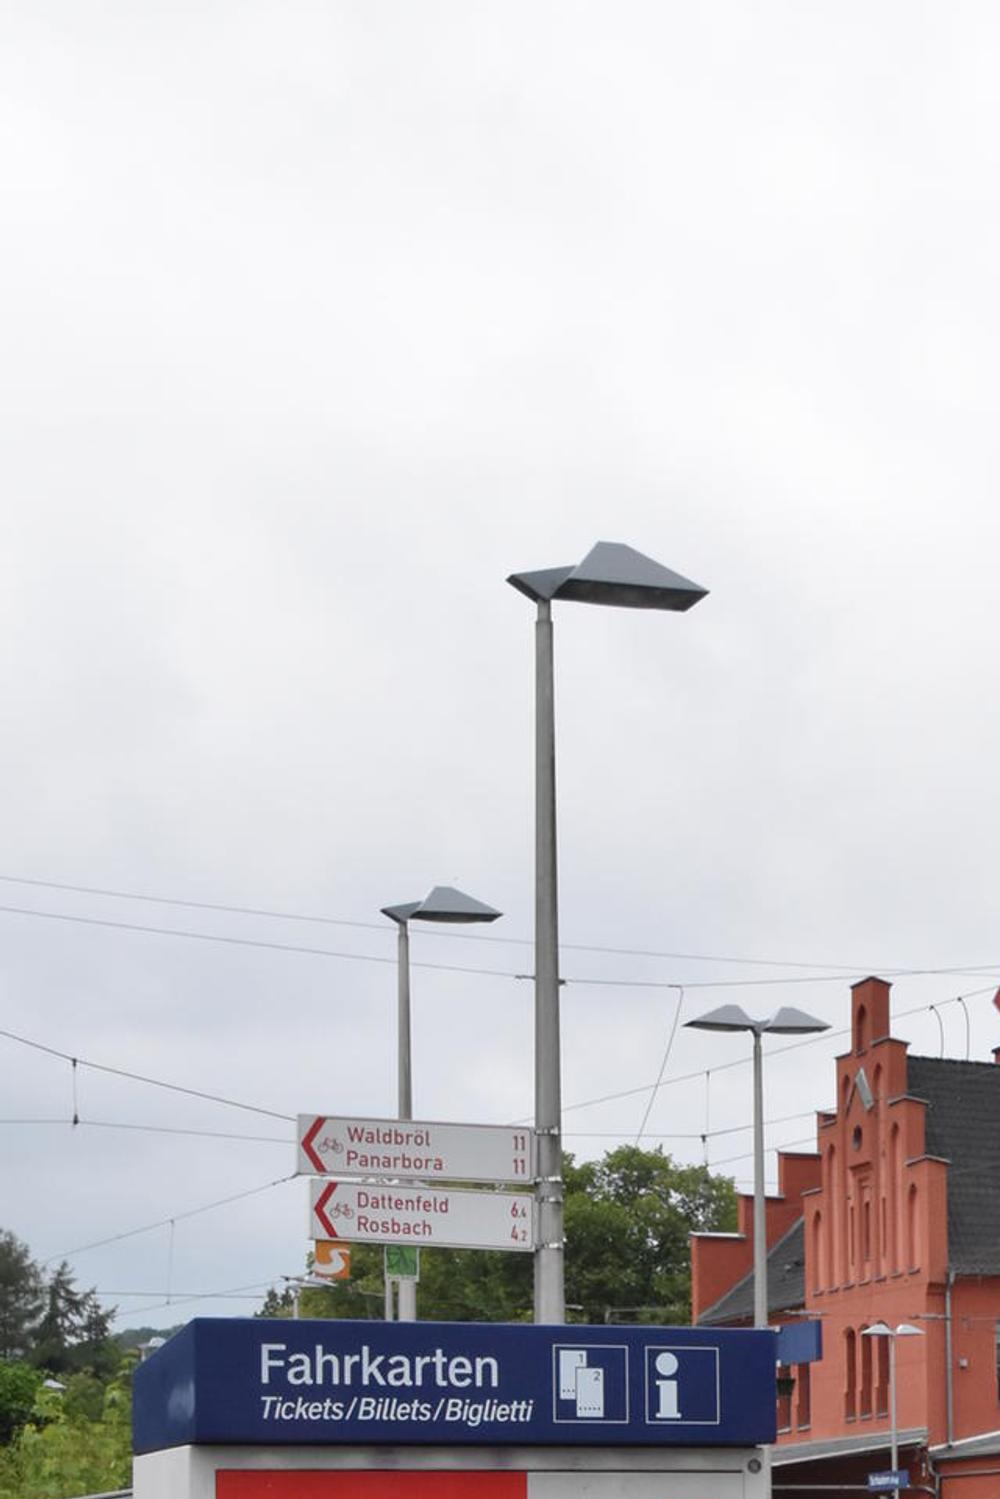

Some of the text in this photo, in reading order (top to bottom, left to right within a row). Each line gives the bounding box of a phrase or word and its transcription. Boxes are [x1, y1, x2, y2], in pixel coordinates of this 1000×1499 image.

[346, 1126, 430, 1148] Waldbröl
[512, 1135, 525, 1151] 11
[346, 1151, 444, 1172] Panarbora
[512, 1158, 525, 1174] 11
[356, 1192, 450, 1214] Dattenfeld
[356, 1216, 433, 1237] Rosbach
[260, 1343, 499, 1388] Fahrkarten
